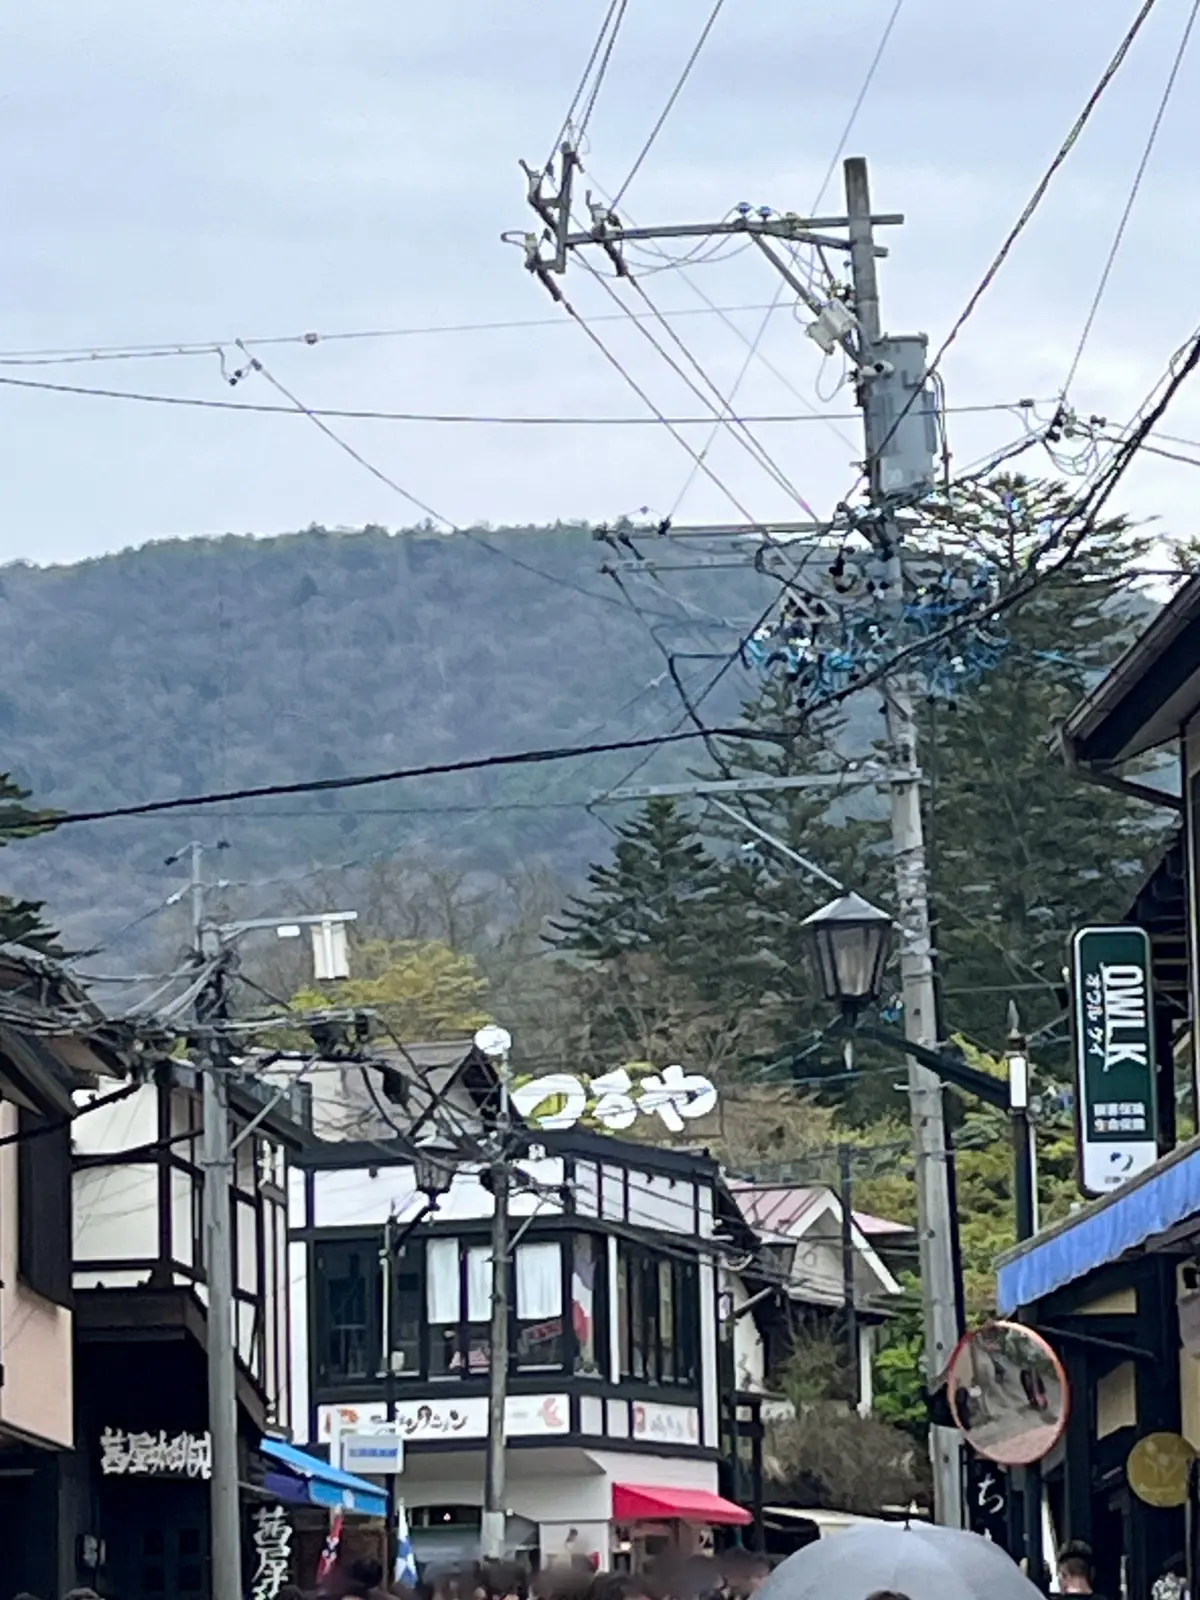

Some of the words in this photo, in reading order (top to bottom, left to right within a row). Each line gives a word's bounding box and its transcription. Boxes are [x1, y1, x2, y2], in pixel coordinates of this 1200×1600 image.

[1101, 964, 1147, 1070] OWLK
[510, 1065, 717, 1132] つるや
